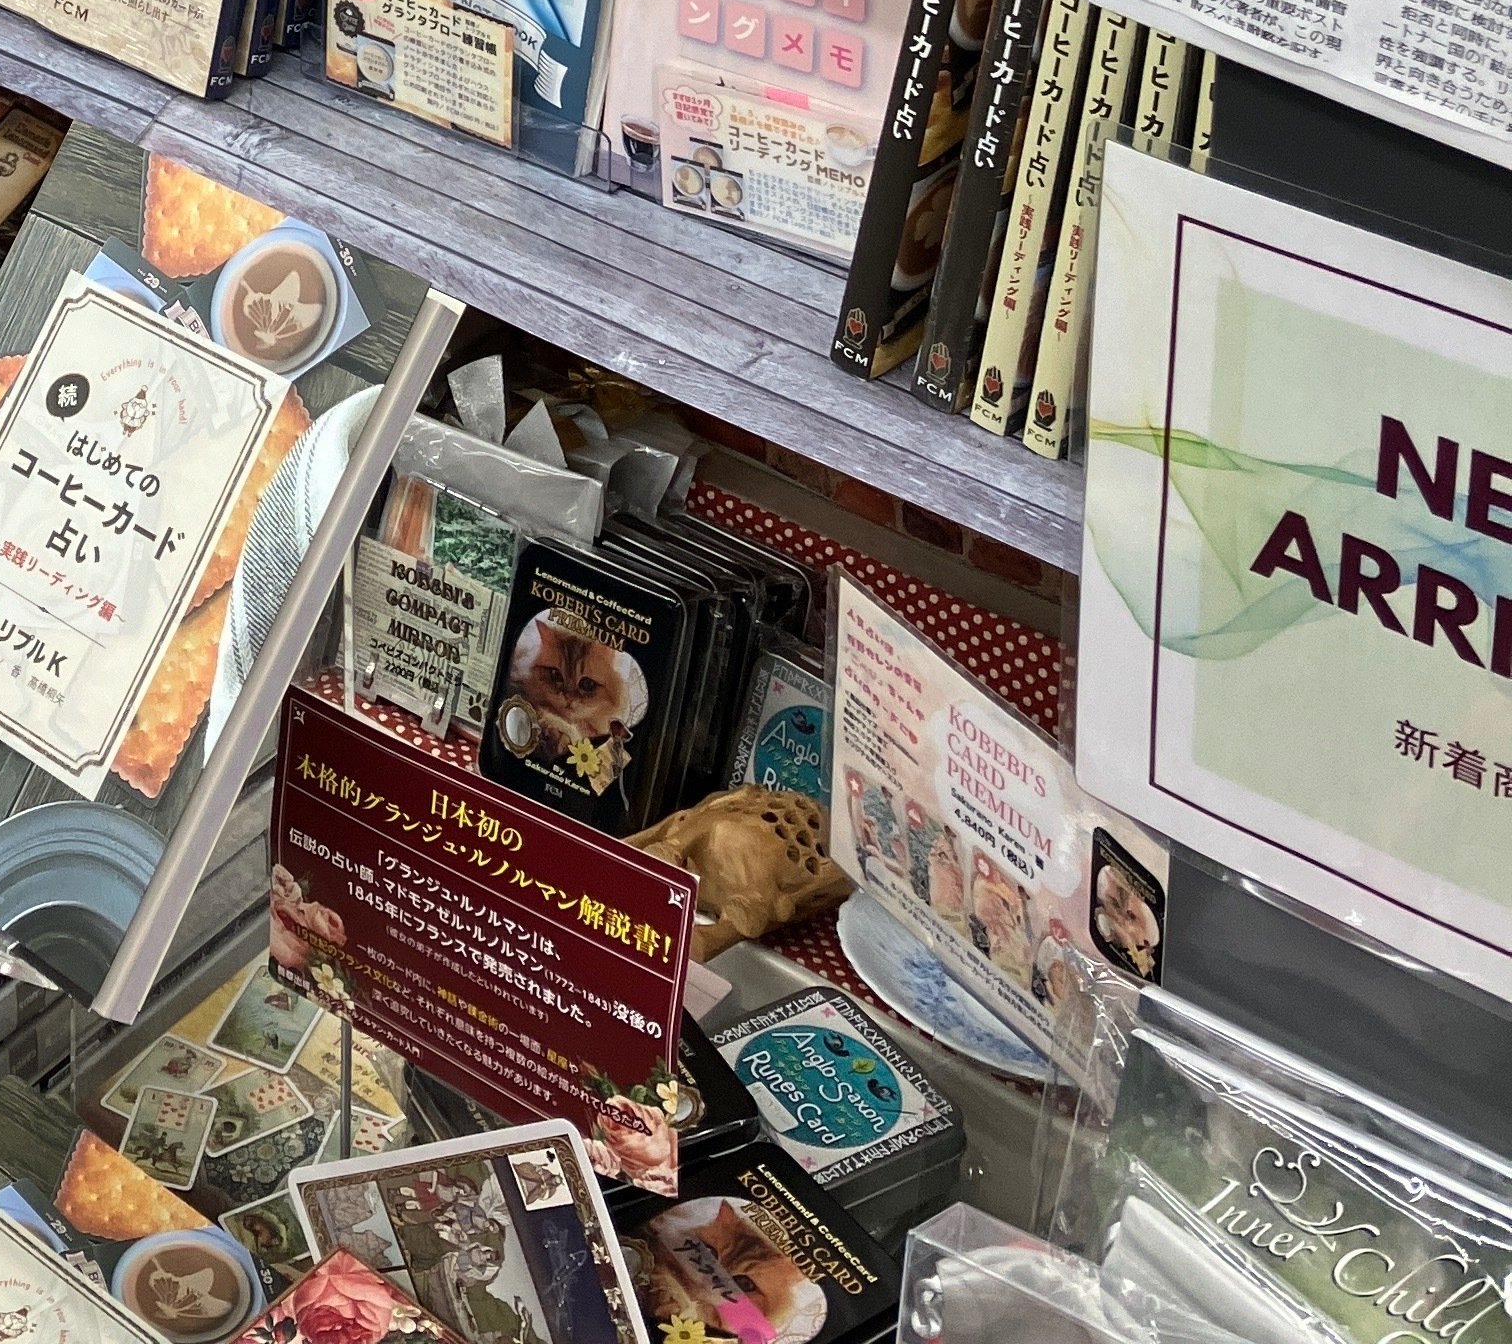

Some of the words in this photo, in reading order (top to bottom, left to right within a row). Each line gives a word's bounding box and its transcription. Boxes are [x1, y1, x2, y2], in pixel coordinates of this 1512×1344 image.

[380, 1, 498, 58] グランタブロー練習帳
[686, 1, 857, 73] ングメモ
[728, 123, 826, 163] コーヒーカード
[728, 136, 814, 173] リーディング
[815, 163, 866, 190] MEMO
[834, 340, 870, 368] FCM
[55, 381, 81, 409] 続
[915, 374, 955, 403] FCM
[65, 431, 162, 499] はじめての
[1375, 414, 1512, 544] NE
[9, 451, 187, 564] コーヒーカード
[44, 530, 107, 567] 占い
[530, 580, 602, 628] KOBEBI'S
[604, 615, 650, 646] CARD
[1249, 509, 1512, 680] ARRI
[946, 732, 1006, 793] CARD
[947, 703, 1048, 799] KOBEBI'S
[430, 788, 524, 852] 日本初の
[945, 758, 1053, 858] PREMIUM
[739, 1047, 806, 1110] Runes
[788, 1098, 847, 1146] Card
[789, 1027, 888, 1135] Anglo-Saxon
[1197, 1173, 1320, 1262] Inner
